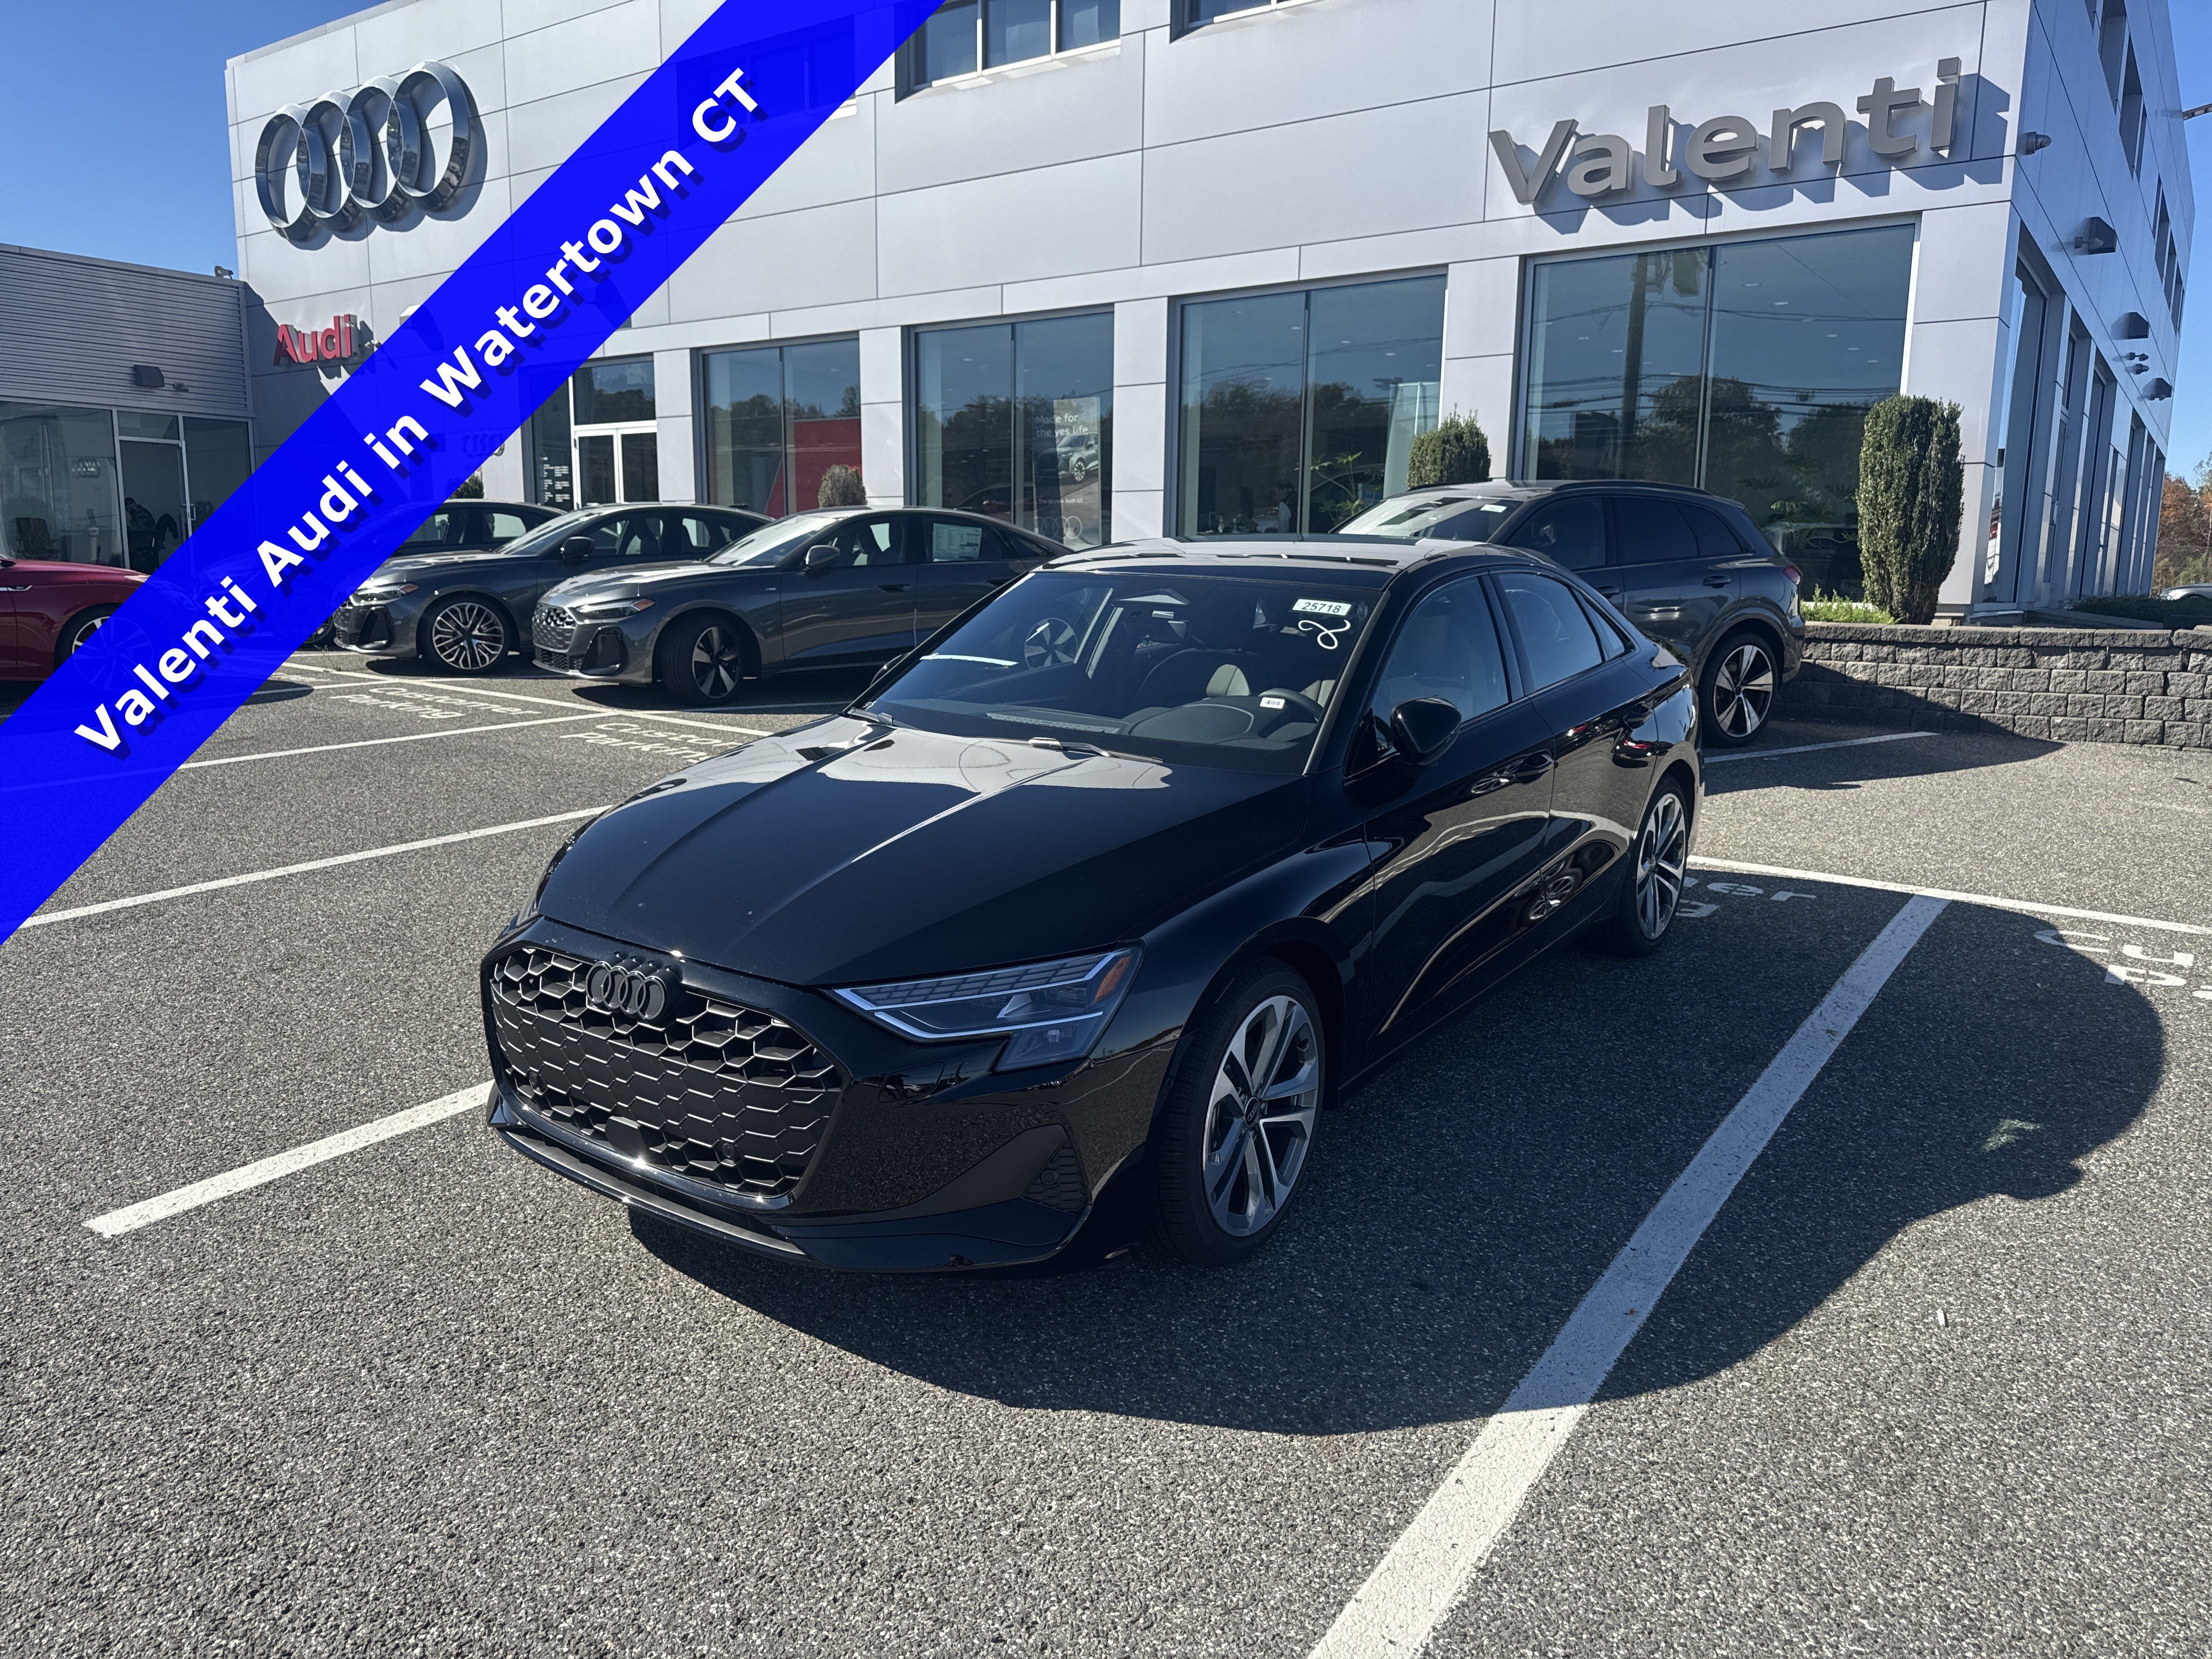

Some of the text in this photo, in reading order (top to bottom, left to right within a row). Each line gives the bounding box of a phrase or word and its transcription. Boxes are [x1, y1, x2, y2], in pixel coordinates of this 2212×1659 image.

[1489, 57, 1961, 205] Valenti
[273, 314, 352, 366] Audi
[1064, 413, 1079, 422] for
[1036, 427, 1052, 437] the
[1073, 425, 1088, 435] life
[1301, 602, 1341, 613] 25718
[330, 693, 466, 719] Parking
[369, 687, 541, 715] Customer
